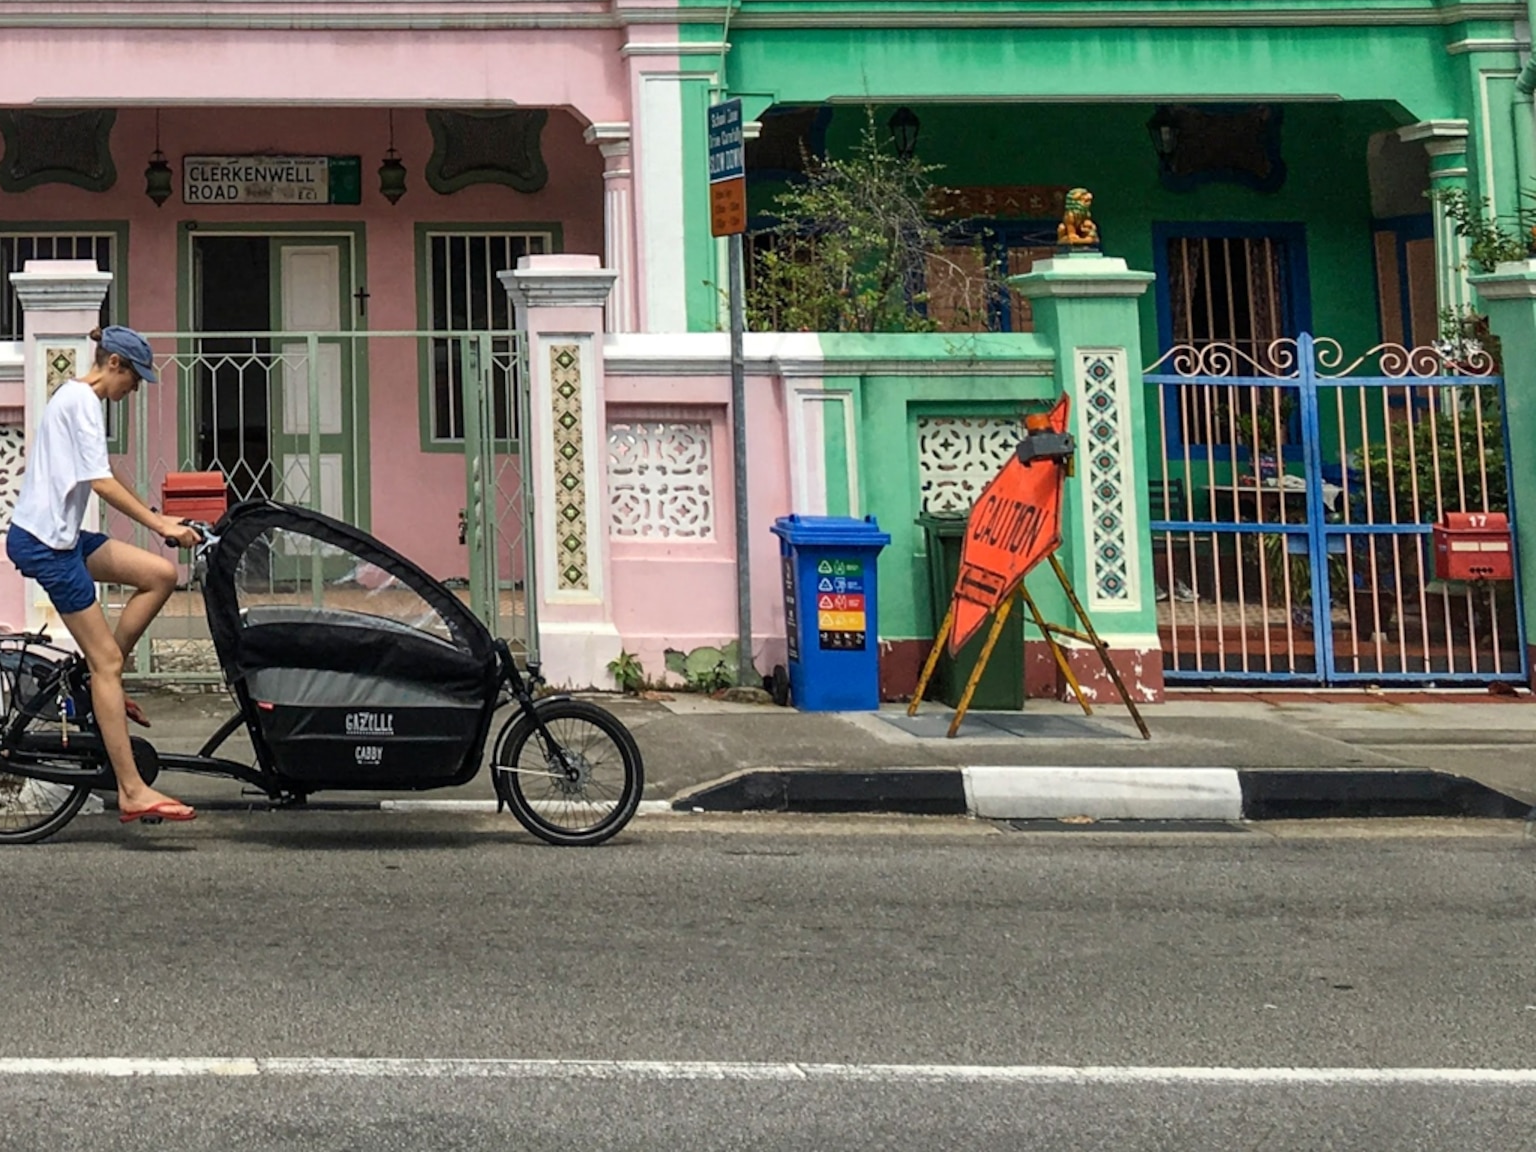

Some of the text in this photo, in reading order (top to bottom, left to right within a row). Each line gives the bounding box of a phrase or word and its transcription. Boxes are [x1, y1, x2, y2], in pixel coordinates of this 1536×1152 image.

[189, 166, 315, 183] CLERKENWELL
[188, 184, 239, 200] ROAD
[973, 495, 1049, 558] CAUTION
[1469, 515, 1487, 527] 17
[345, 712, 394, 732] GAZELLE
[355, 746, 383, 760] CABBY
